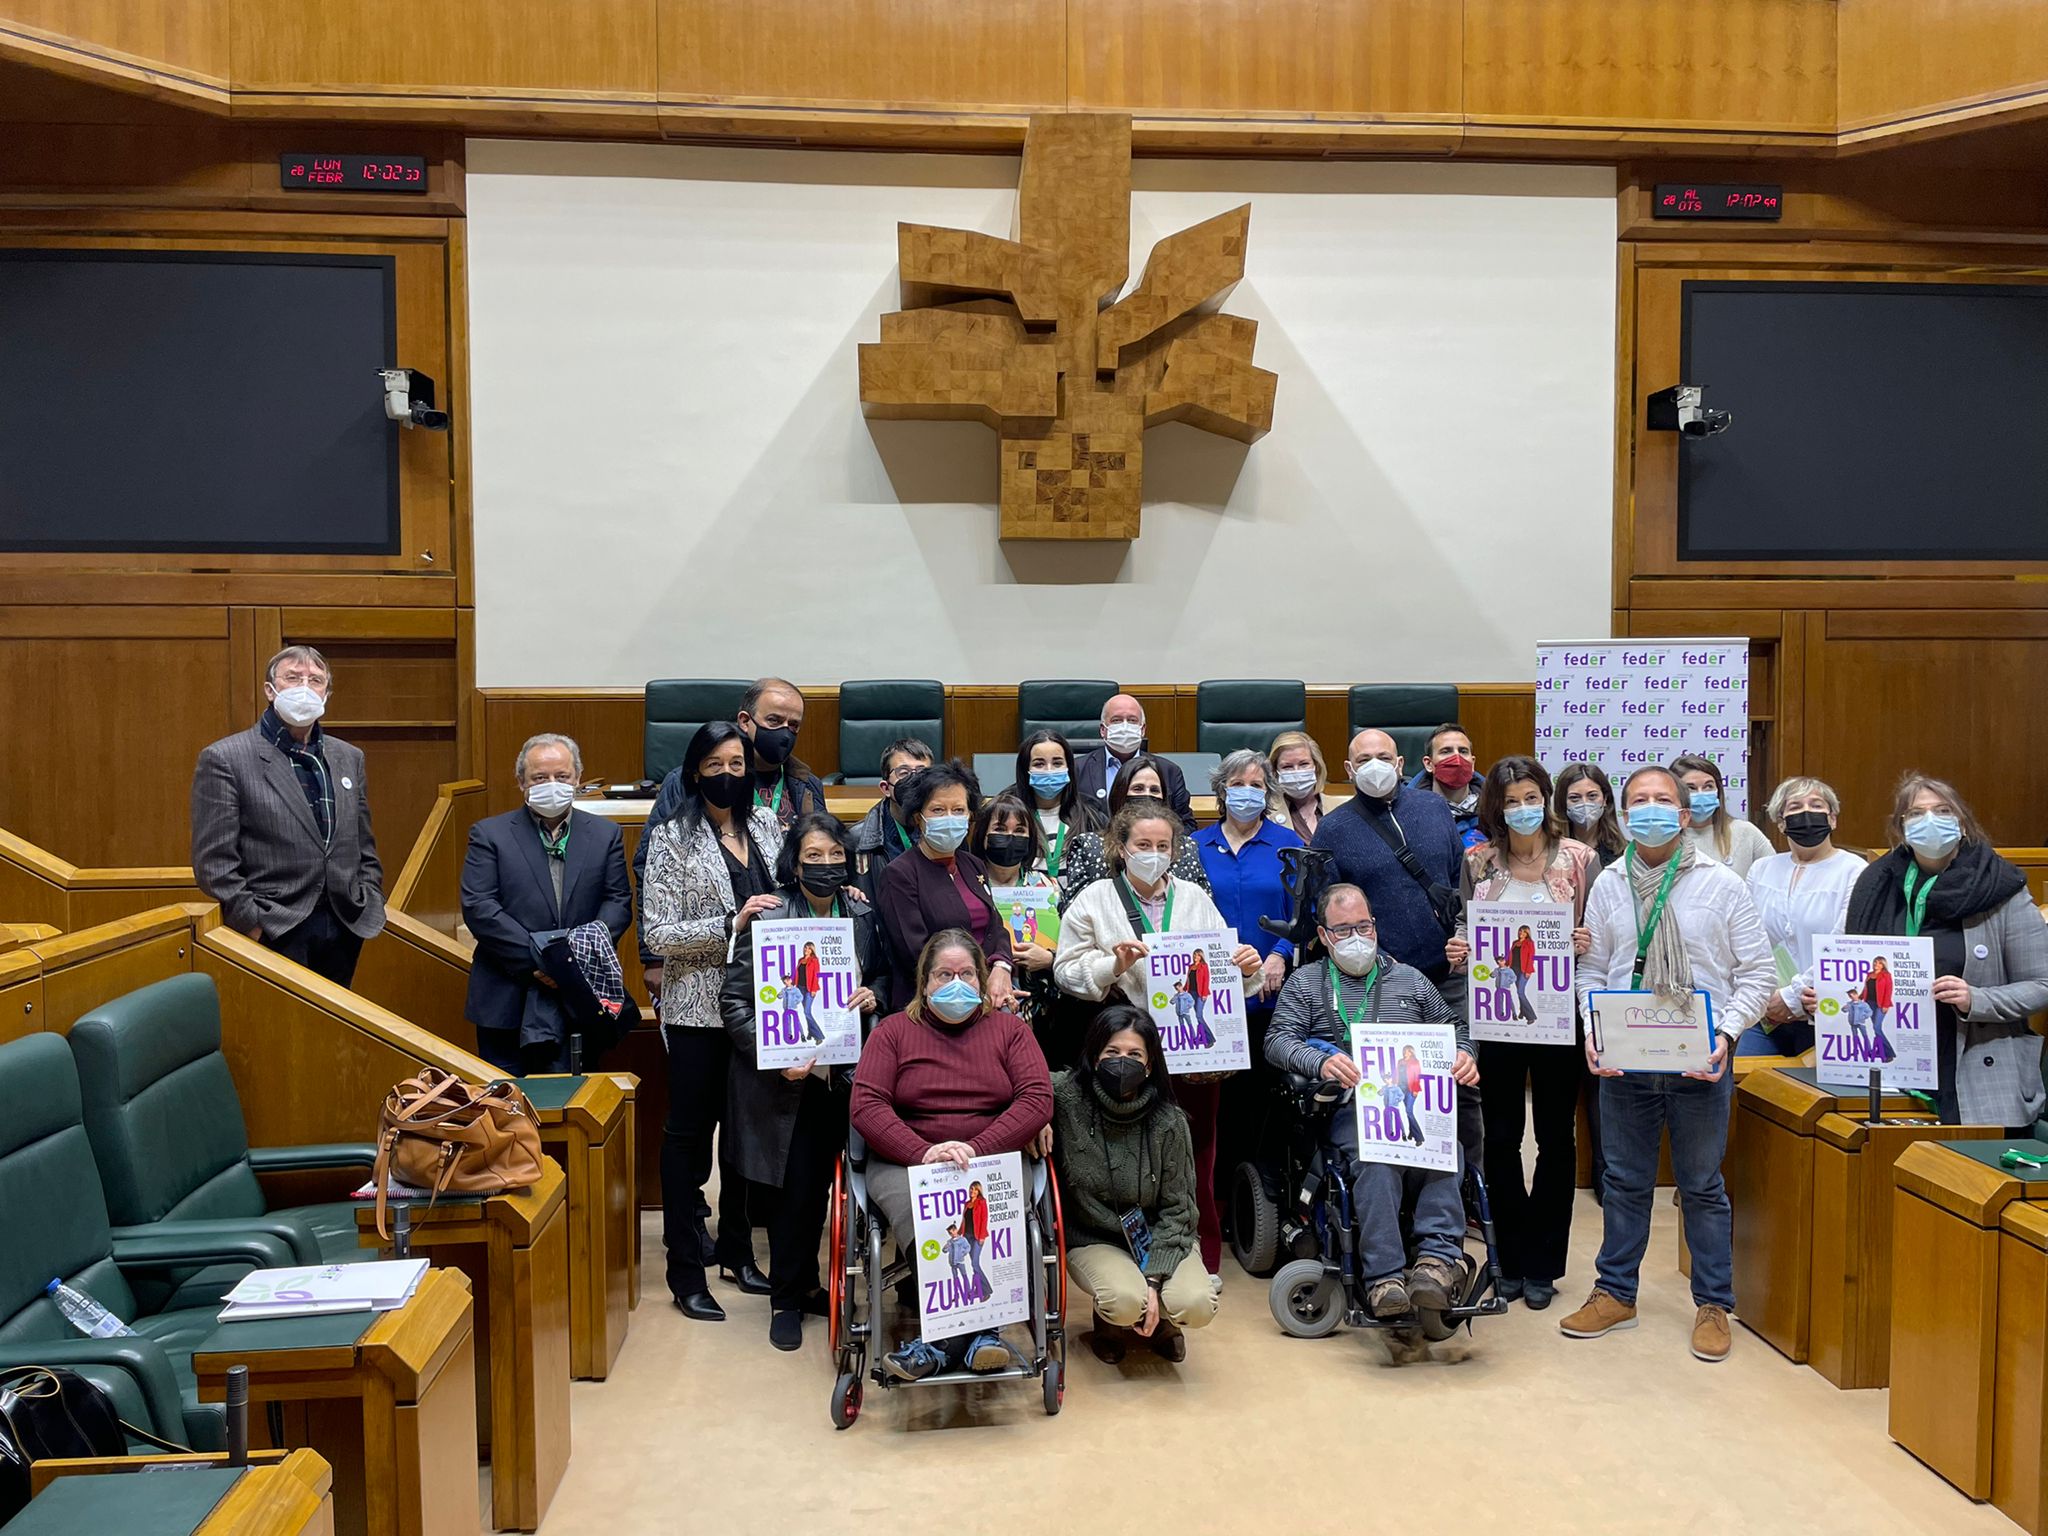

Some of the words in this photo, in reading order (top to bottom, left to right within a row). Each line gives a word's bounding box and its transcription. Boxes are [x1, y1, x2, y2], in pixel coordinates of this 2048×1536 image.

[314, 159, 342, 170] LUN
[308, 172, 344, 183] FEBR
[363, 164, 403, 180] 12:02
[1663, 195, 1676, 205] 28
[1684, 189, 1699, 200] AL
[1564, 653, 1606, 666] feder
[1622, 652, 1665, 665] feder
[1682, 651, 1726, 665] feder
[1536, 677, 1570, 690] eder
[1586, 677, 1628, 690] feder
[1644, 676, 1688, 689] feder
[1704, 676, 1747, 689] feder
[1563, 701, 1606, 714] feder
[1622, 701, 1665, 714] feder
[1681, 700, 1725, 714] feder
[1535, 726, 1569, 738] eder
[1585, 725, 1627, 738] feder
[1644, 725, 1688, 738] feder
[1704, 725, 1747, 738] feder
[1563, 749, 1605, 762] feder
[1621, 749, 1664, 762] feder
[1537, 920, 1560, 929] ¿CÓMO
[821, 935, 842, 945] ¿CÓMO
[1537, 931, 1546, 939] TE
[1547, 931, 1560, 939] VES
[1208, 943, 1222, 951] NOLA
[1475, 926, 1510, 961] FU
[1537, 941, 1546, 949] EN
[1548, 941, 1570, 950] 2030?
[821, 947, 829, 955] TE
[830, 946, 842, 955] VES
[1893, 952, 1911, 960] NOLA
[761, 944, 796, 982] FU
[822, 957, 830, 966] EN
[831, 957, 851, 966] 2030?
[1893, 961, 1920, 969] IKUSTEN
[1533, 955, 1570, 992] TU
[1894, 979, 1916, 987] BURUA
[816, 972, 853, 1009] TU
[1212, 989, 1232, 1015] KI
[1475, 987, 1512, 1022] RO
[1895, 1002, 1919, 1030] KI
[761, 1009, 800, 1046] RO
[1421, 1050, 1431, 1058] TE
[1432, 1050, 1443, 1059] VES
[1822, 1034, 1886, 1063] ZUNA
[1360, 1046, 1397, 1080] FU
[1422, 1060, 1432, 1068] EN
[1418, 1074, 1453, 1114] TU
[1363, 1105, 1401, 1142] RO
[987, 1172, 1002, 1182] NOLA
[987, 1181, 1012, 1192] IKUSTEN
[988, 1192, 1004, 1203] DUZU
[1004, 1190, 1019, 1200] ZURE
[989, 1202, 1008, 1213] BURUA
[990, 1211, 1019, 1223] 2030EAN?
[991, 1227, 1012, 1260] KI
[925, 1273, 985, 1315] ZUNA
